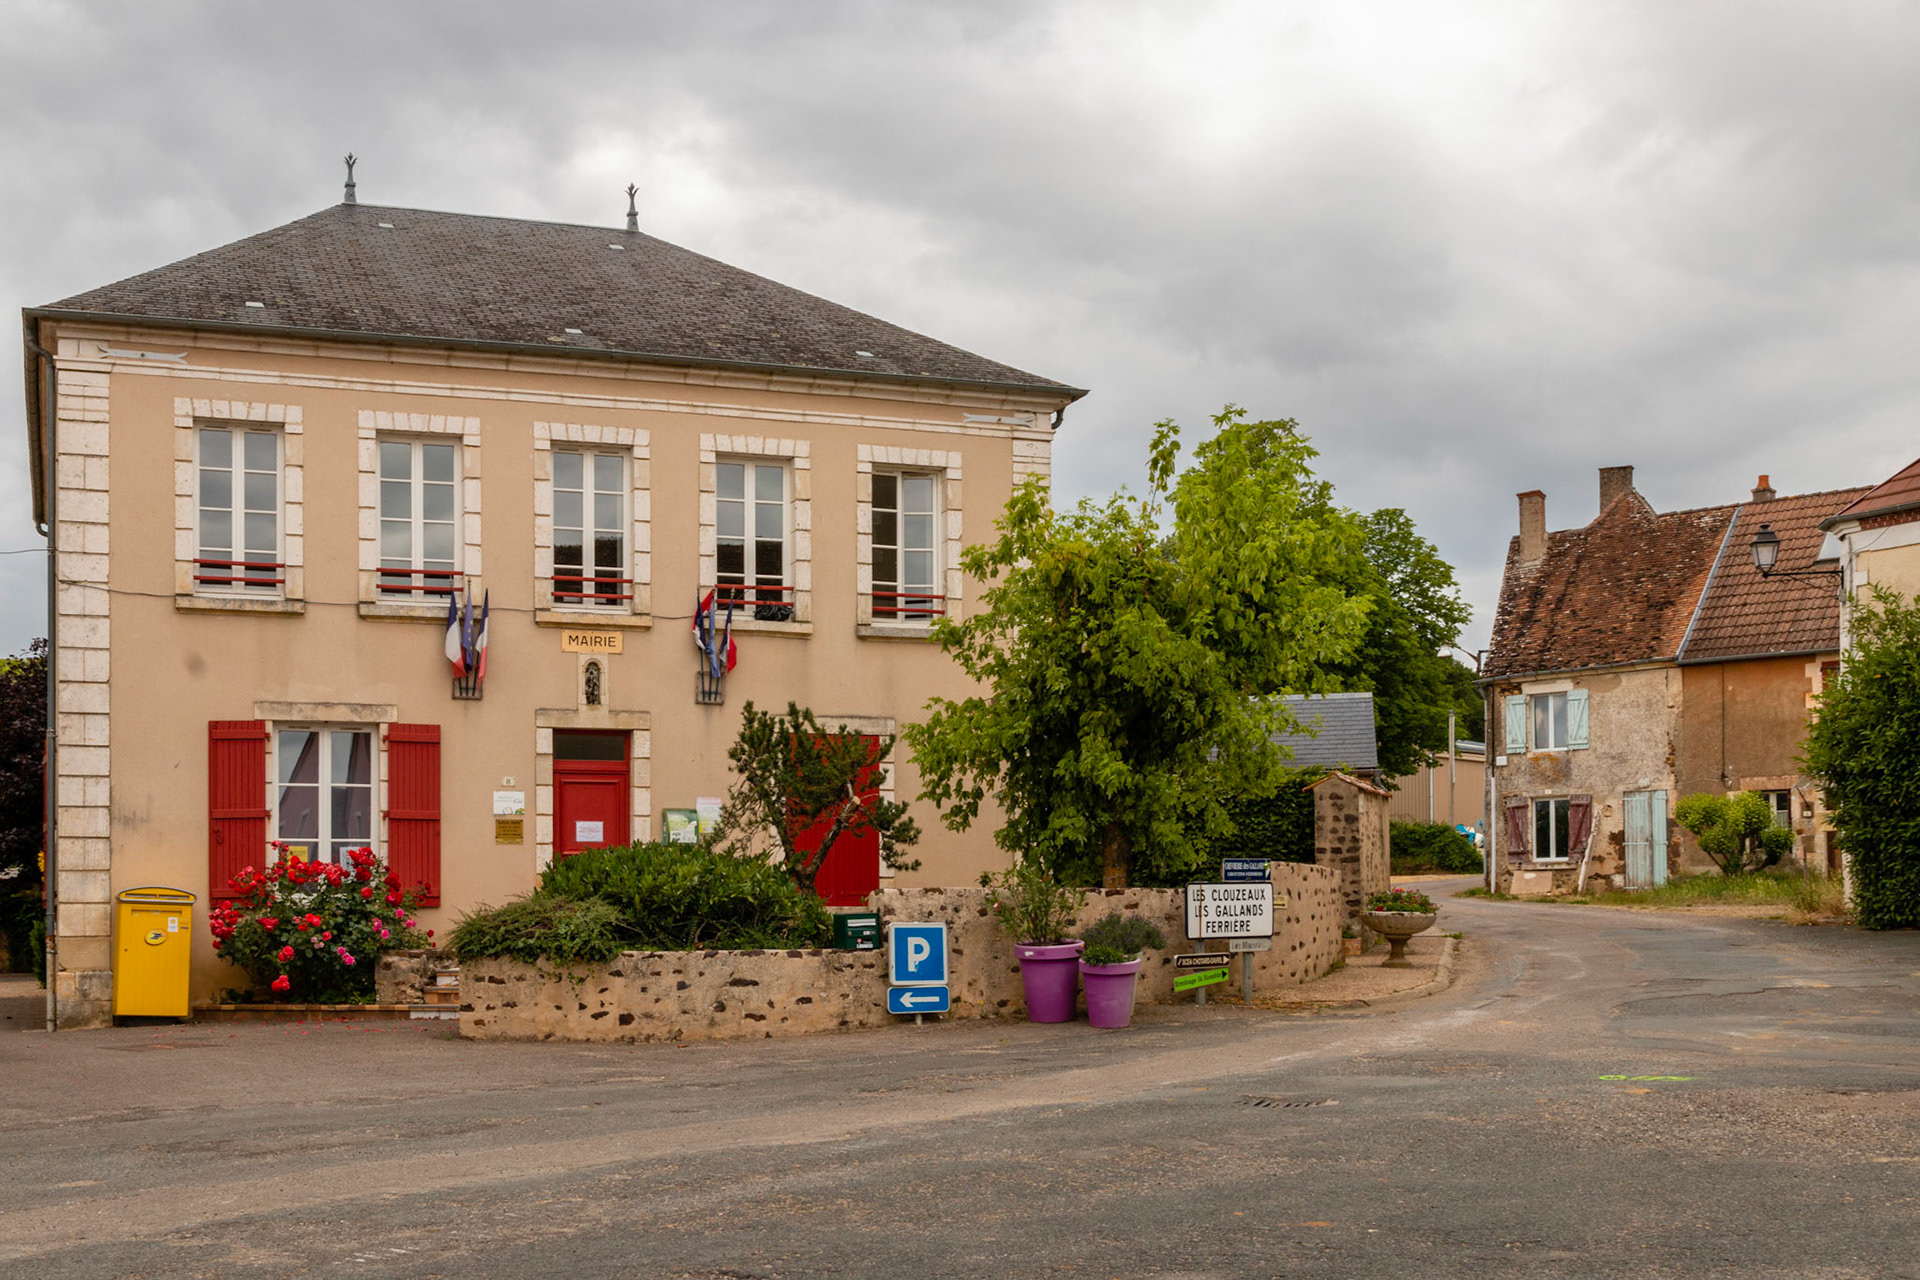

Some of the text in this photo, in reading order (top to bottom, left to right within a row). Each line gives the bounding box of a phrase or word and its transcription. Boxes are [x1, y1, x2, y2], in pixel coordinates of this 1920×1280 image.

[568, 635, 616, 648] MAIRIE
[1192, 889, 1206, 902] LES
[1211, 888, 1266, 901] CLOUZEAUX
[1215, 904, 1264, 917] GALLANDS
[907, 937, 931, 973] P
